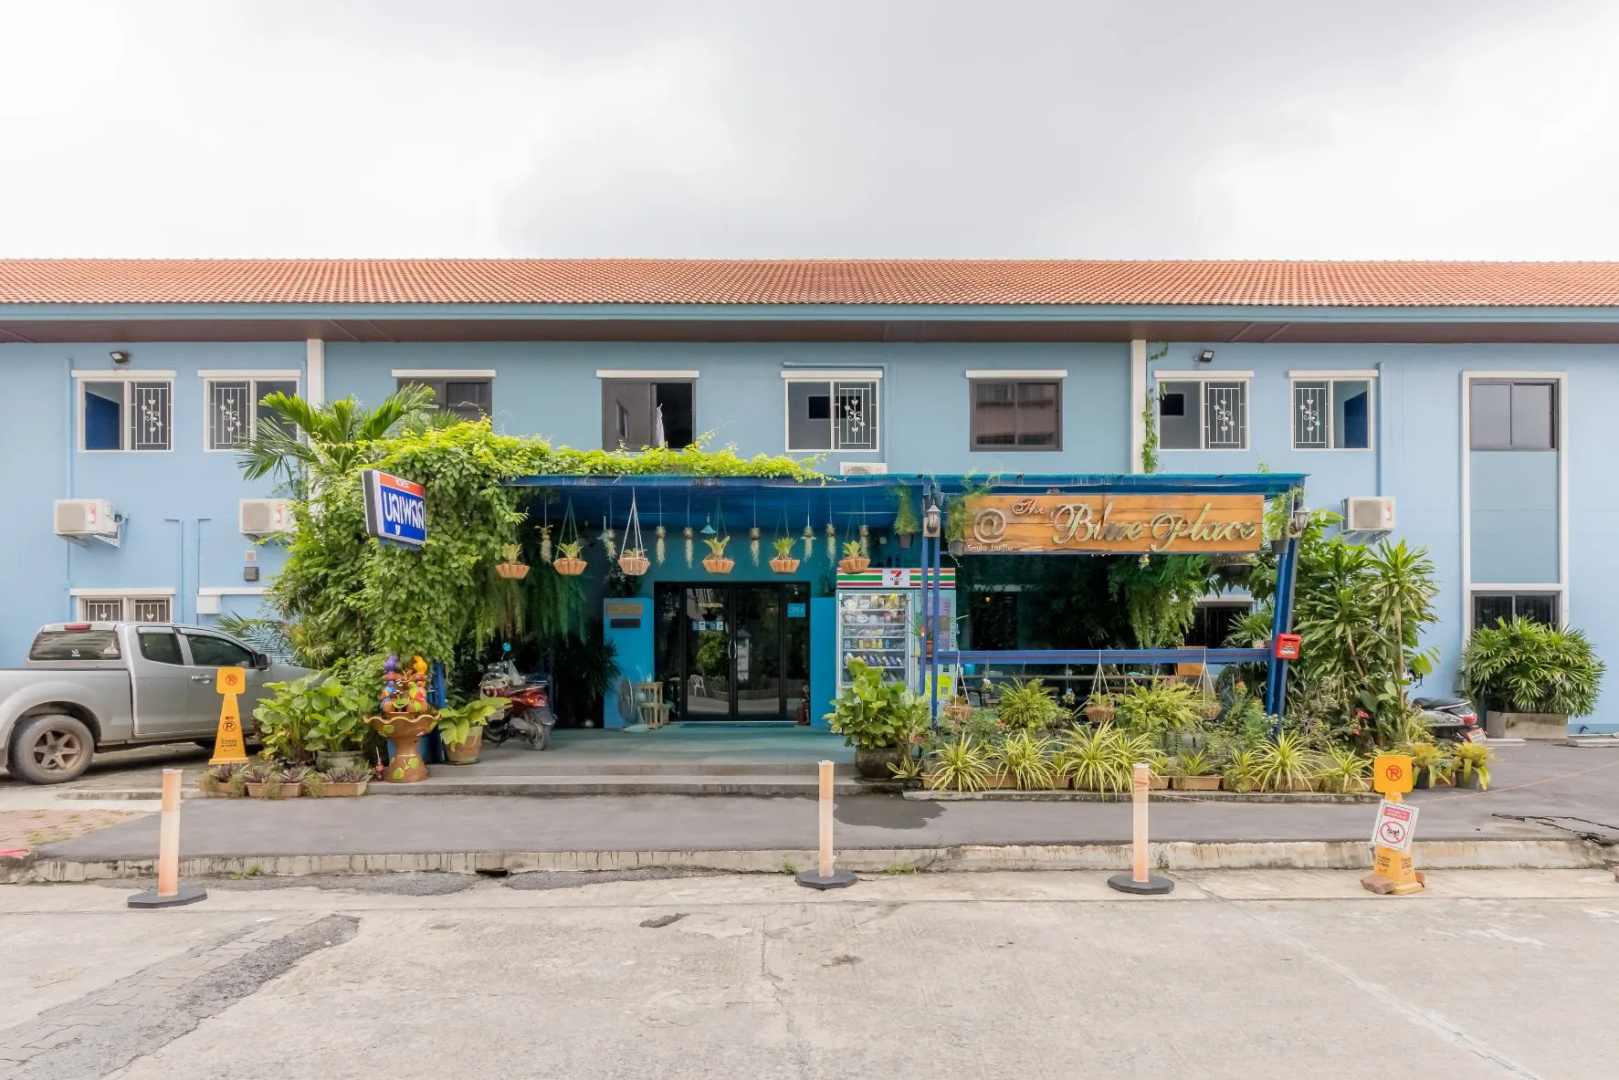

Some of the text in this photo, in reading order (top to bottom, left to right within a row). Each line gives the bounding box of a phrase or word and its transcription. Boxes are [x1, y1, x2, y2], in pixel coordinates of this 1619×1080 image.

[974, 507, 1006, 544] @
[1012, 499, 1045, 515] The
[1050, 501, 1144, 544] Blue
[789, 606, 805, 615] OPEN
